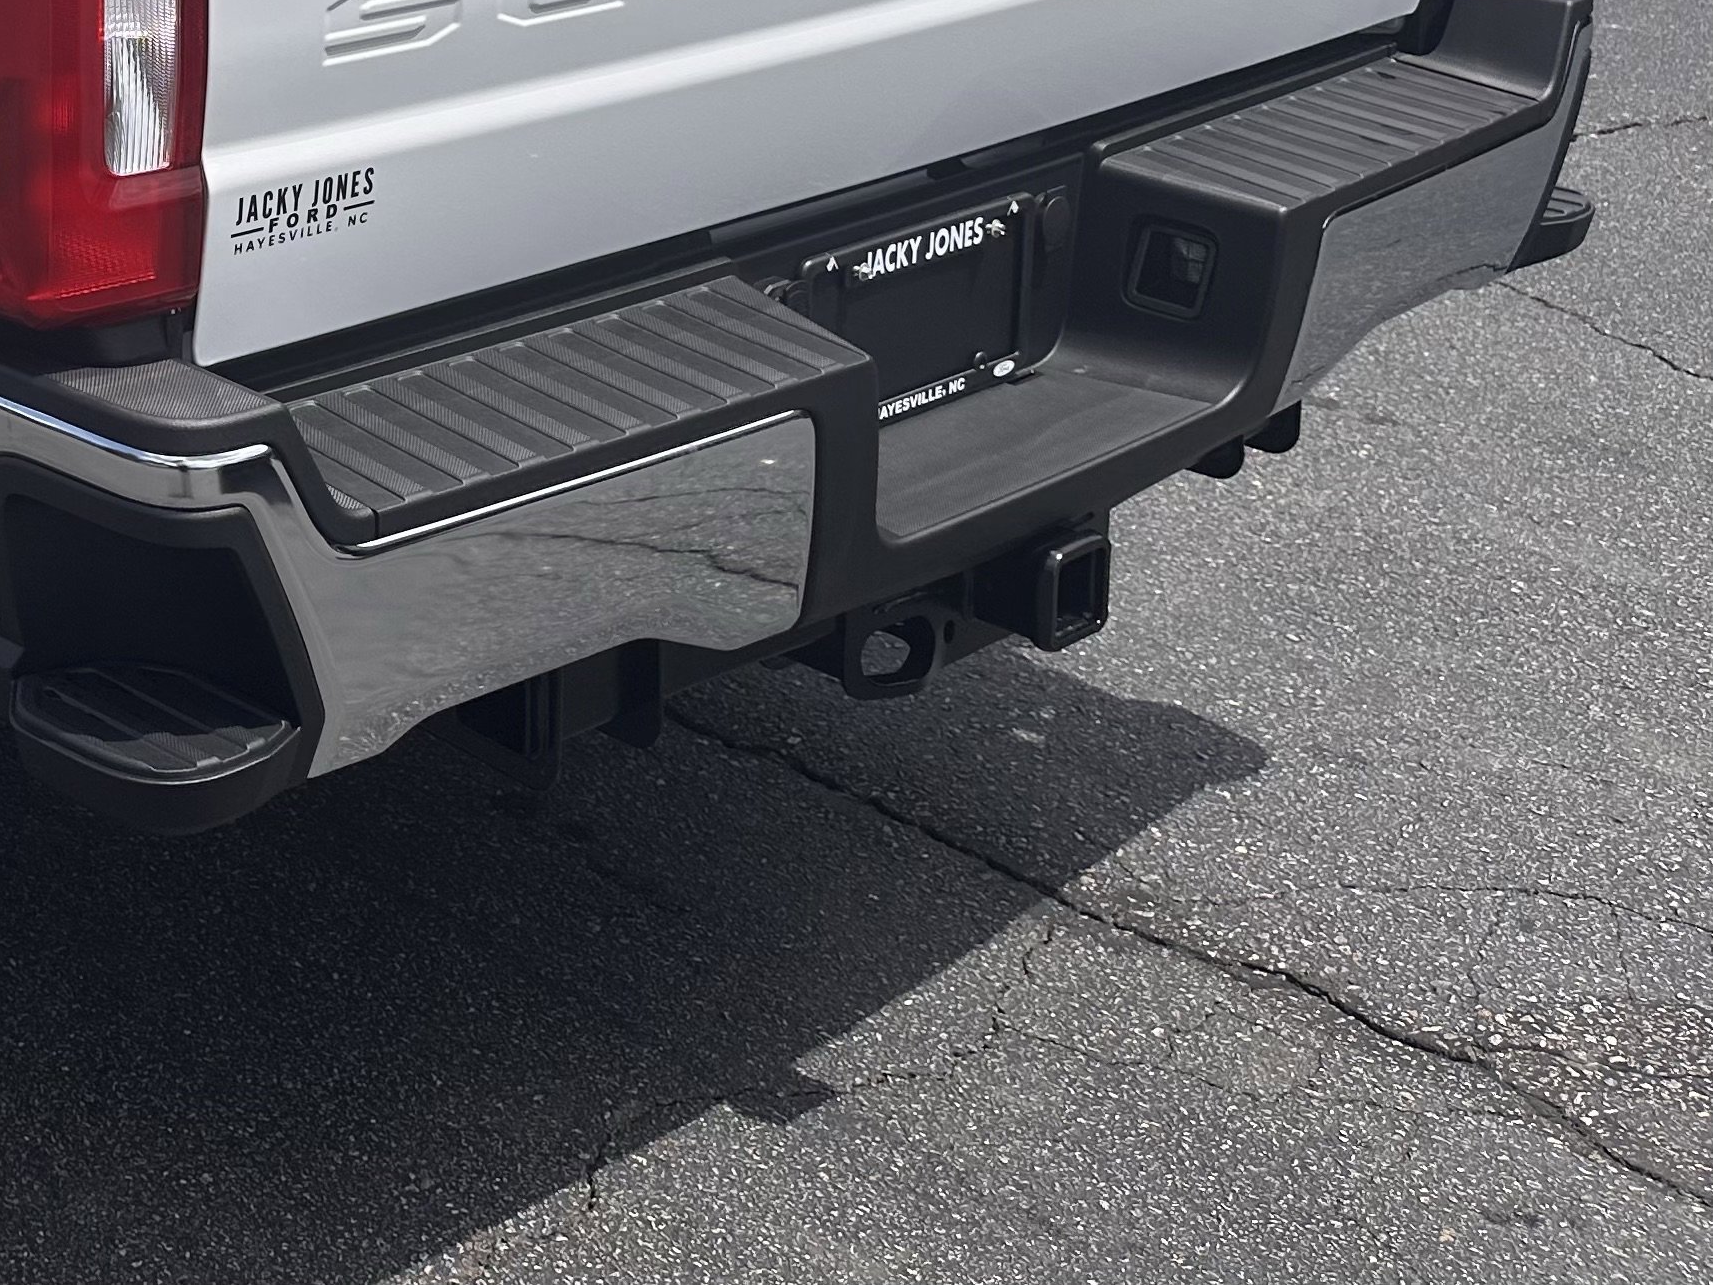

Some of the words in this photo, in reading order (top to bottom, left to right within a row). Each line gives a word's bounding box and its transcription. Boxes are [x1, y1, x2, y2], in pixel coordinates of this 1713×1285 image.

[235, 183, 303, 226] JACKY
[311, 167, 375, 207] JONES
[268, 203, 338, 233] FORD
[347, 212, 369, 227] NC
[863, 235, 922, 279] JACKY
[925, 216, 984, 260] JONES
[877, 384, 947, 420] AYESVILLE,
[948, 377, 966, 395] NC
